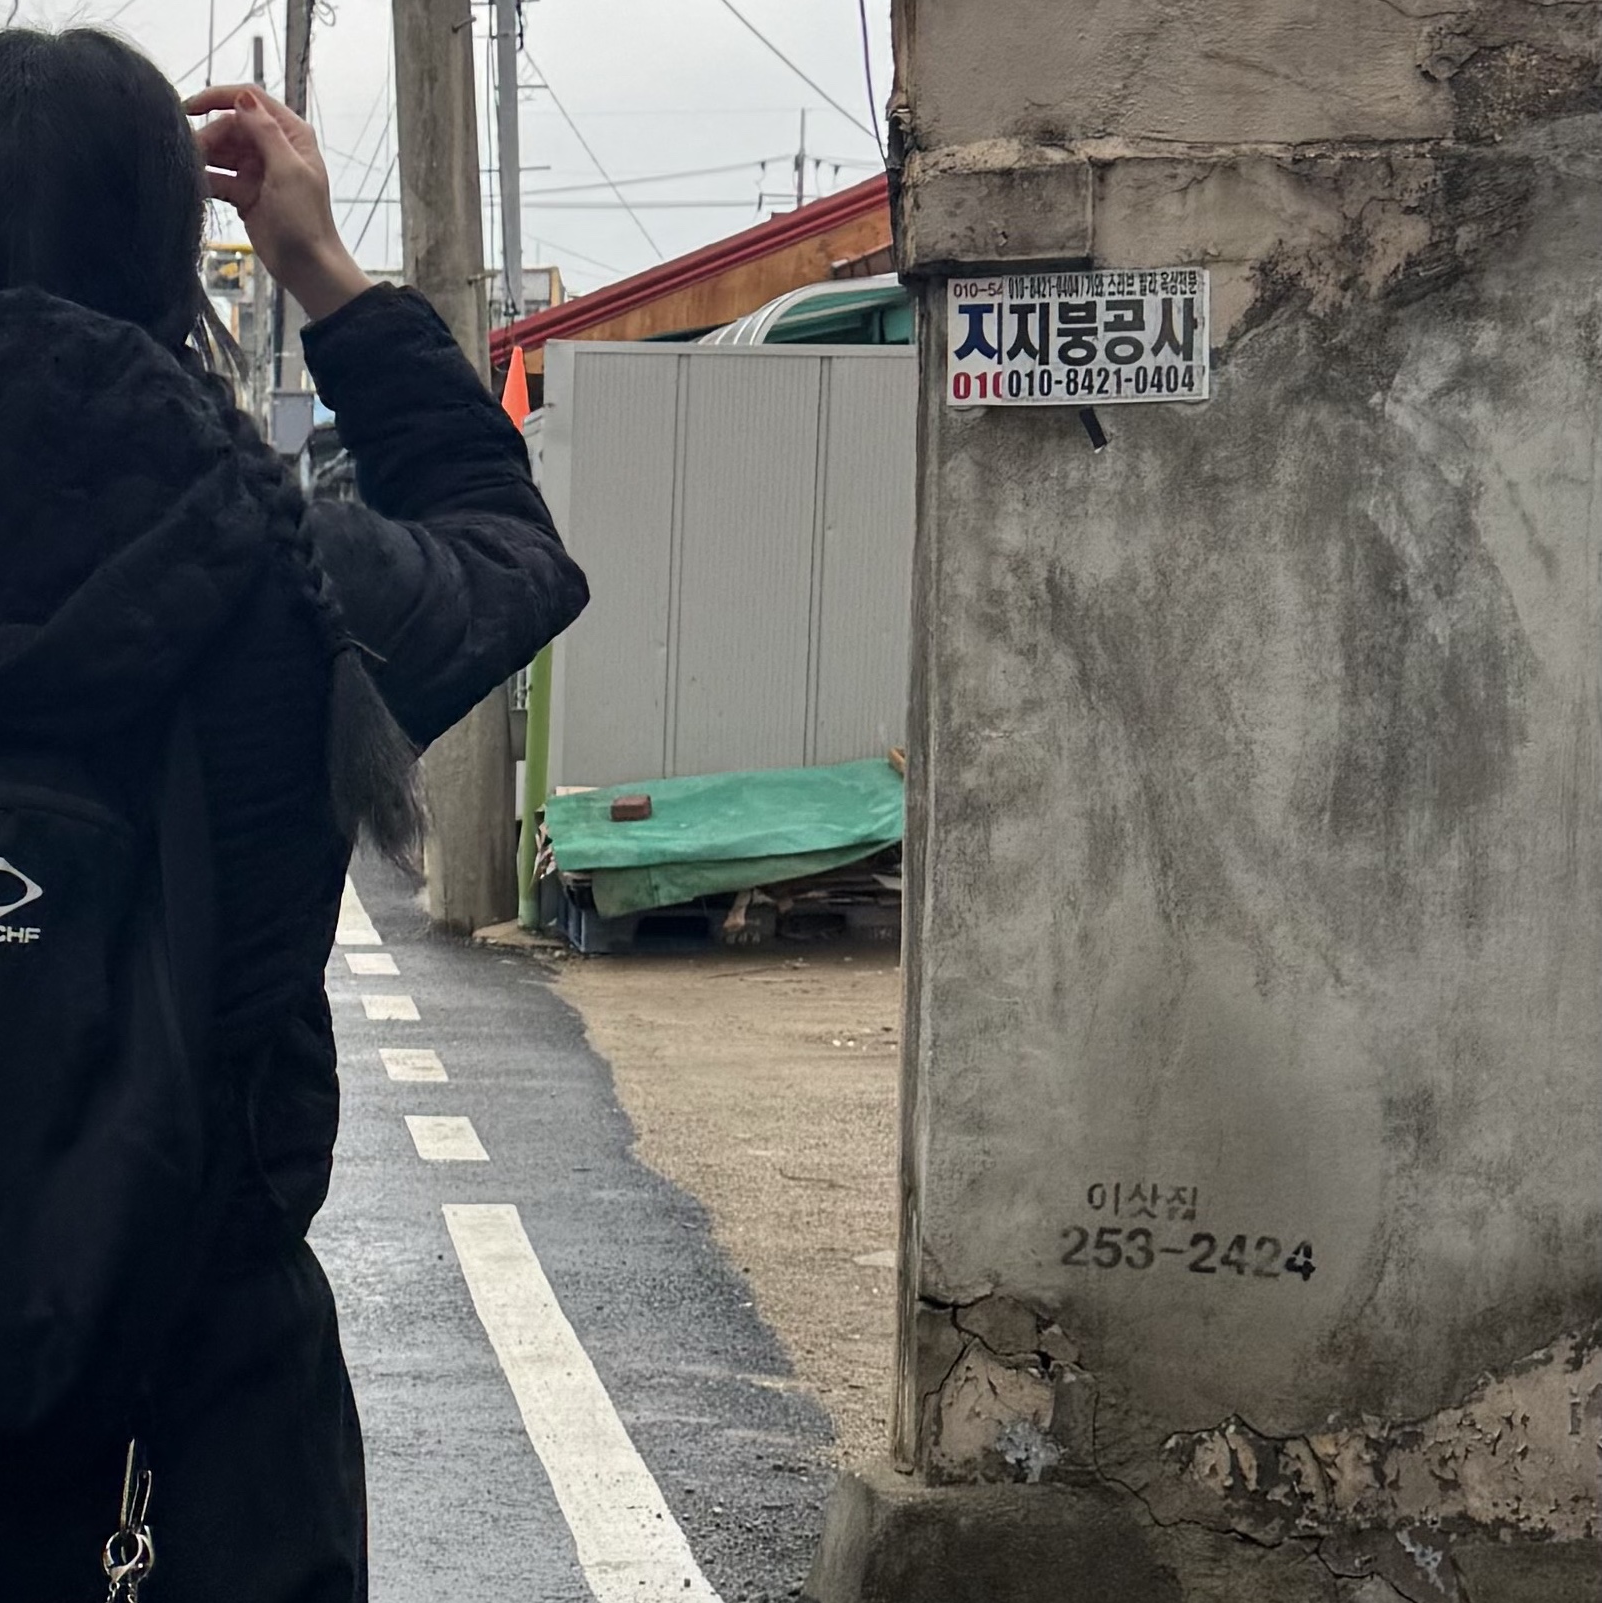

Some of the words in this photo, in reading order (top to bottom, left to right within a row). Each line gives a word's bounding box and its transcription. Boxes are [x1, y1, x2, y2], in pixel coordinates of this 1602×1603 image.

[1006, 297, 1199, 366] 지붕공사
[1007, 365, 1196, 398] 010-8421-0404
[1059, 1225, 1317, 1282] 253-2424
